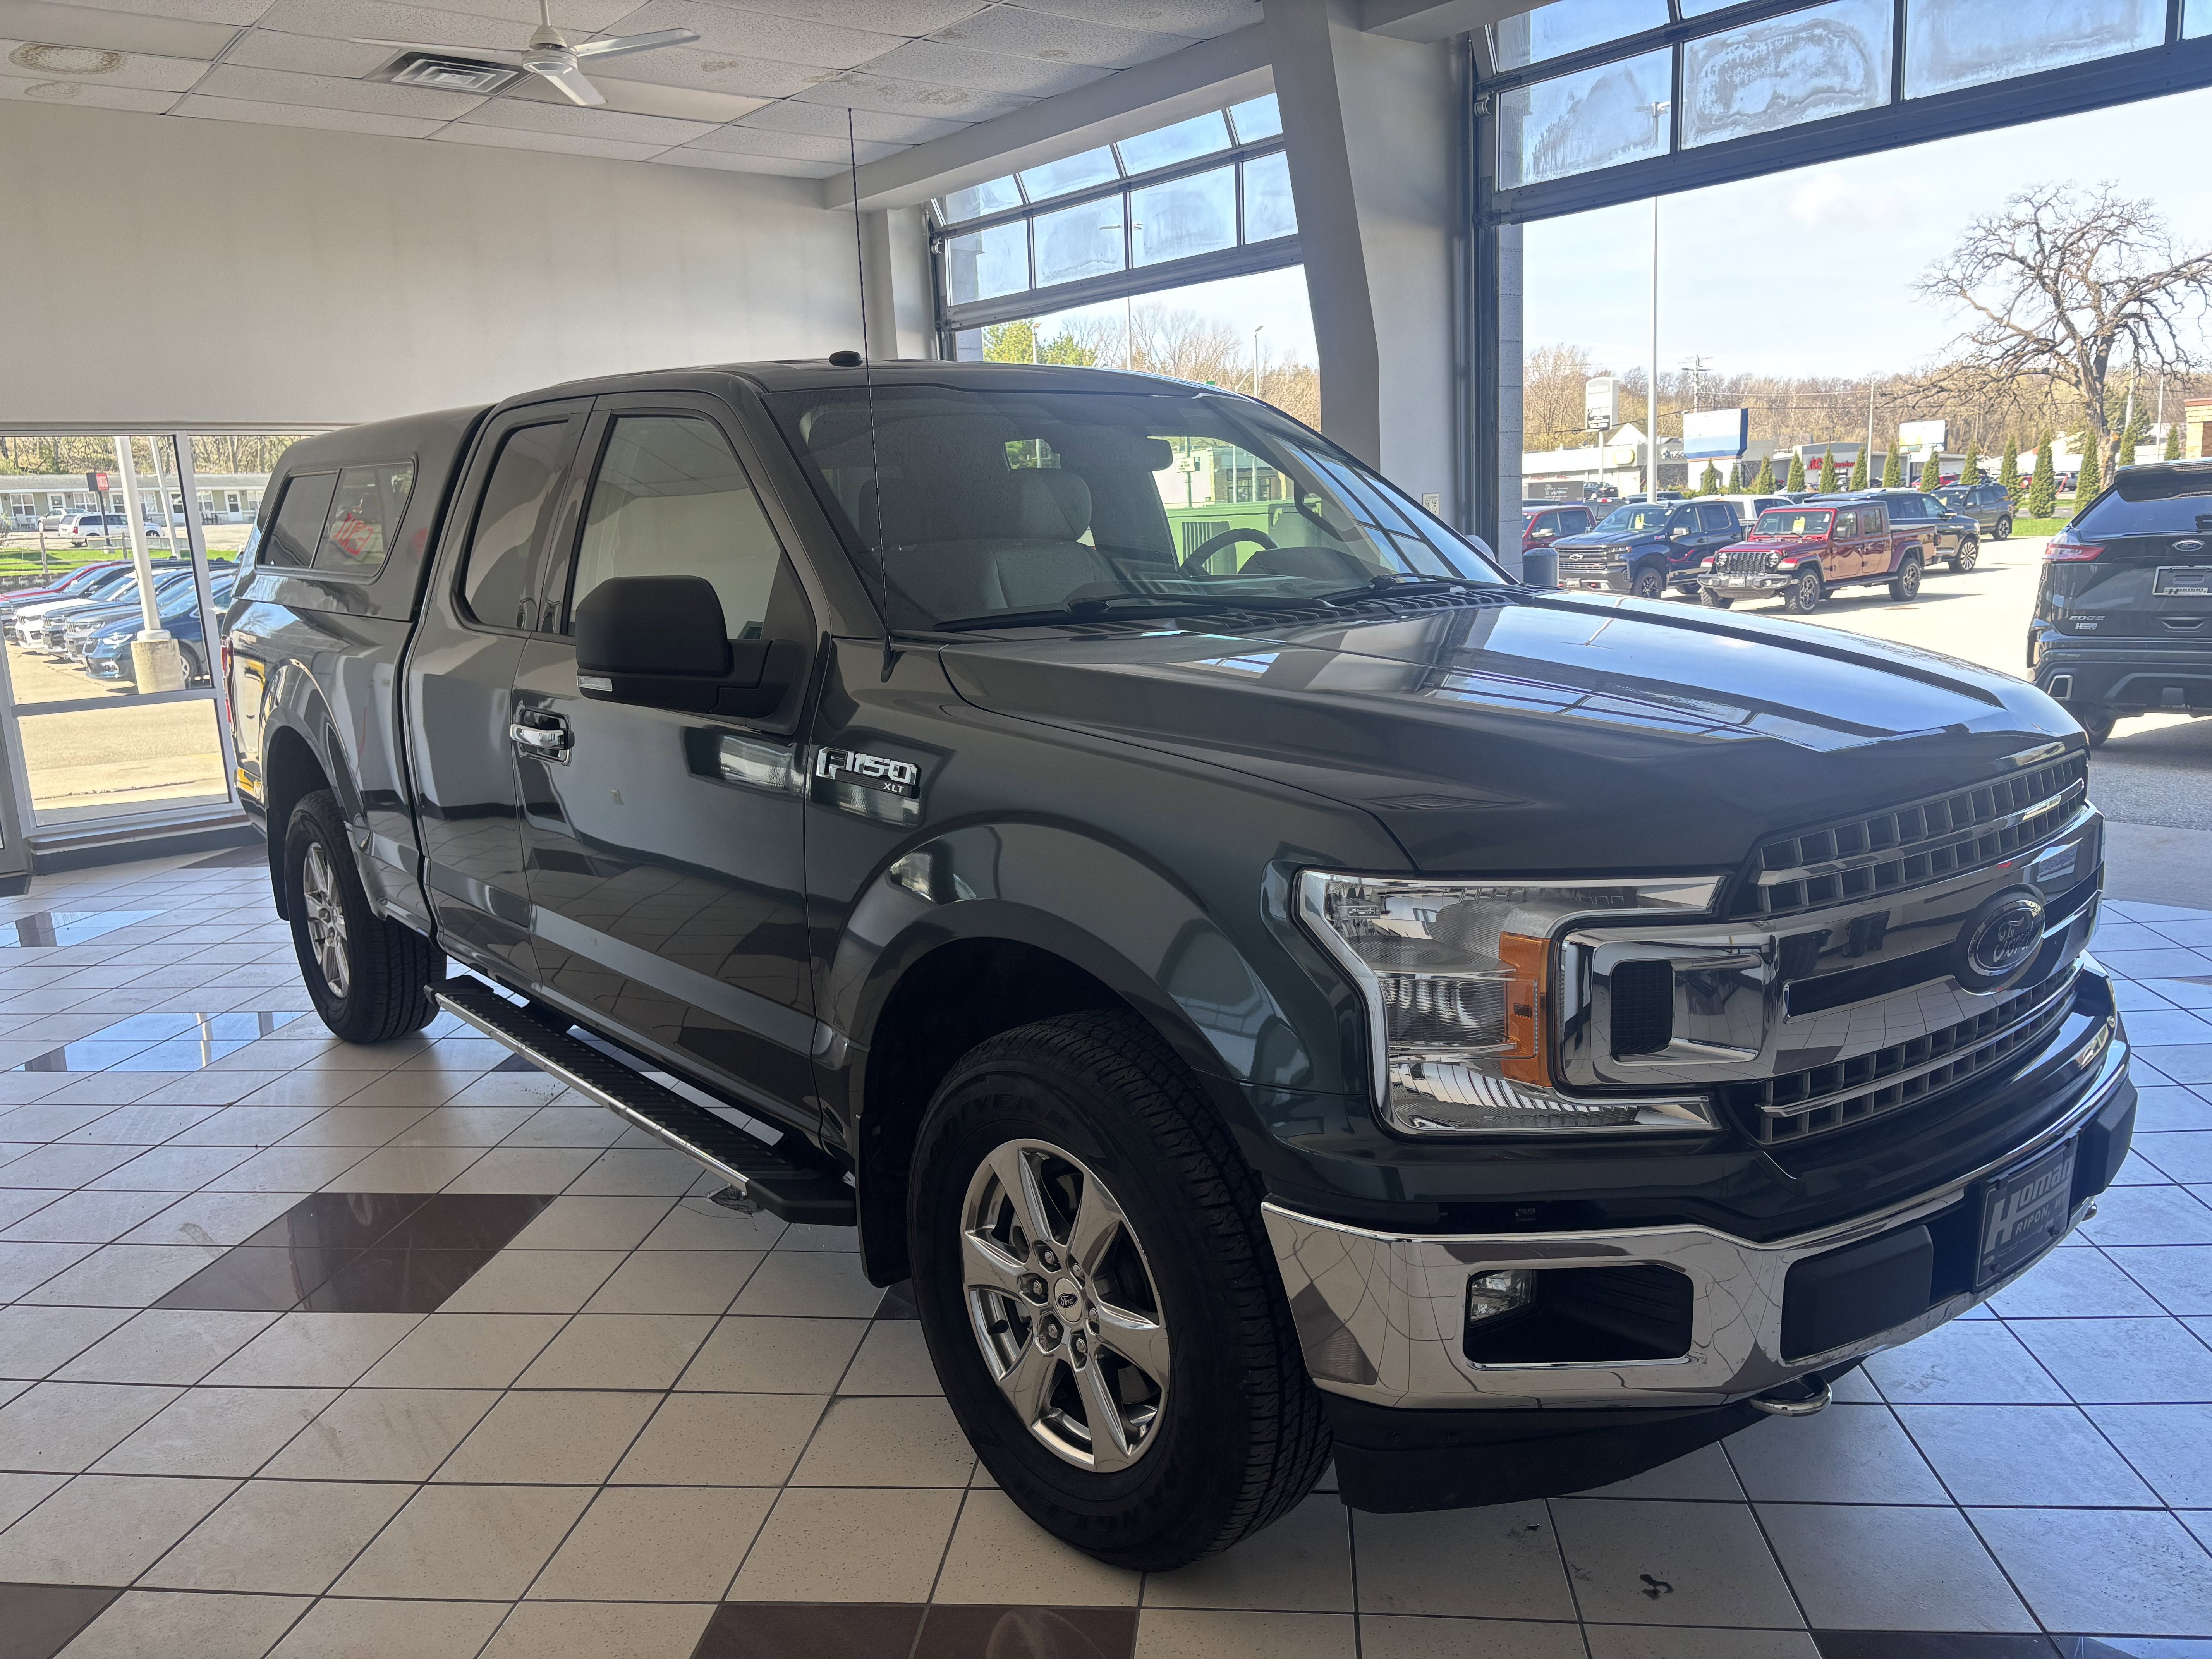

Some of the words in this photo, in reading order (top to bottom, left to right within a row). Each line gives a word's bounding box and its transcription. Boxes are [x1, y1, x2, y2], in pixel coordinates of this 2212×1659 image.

[883, 782, 904, 793] XLT
[1993, 917, 2035, 962] Ford
[1984, 1156, 2074, 1254] Homan
[2015, 1205, 2050, 1235] RIPON,
[1061, 1295, 1074, 1306] Ford
